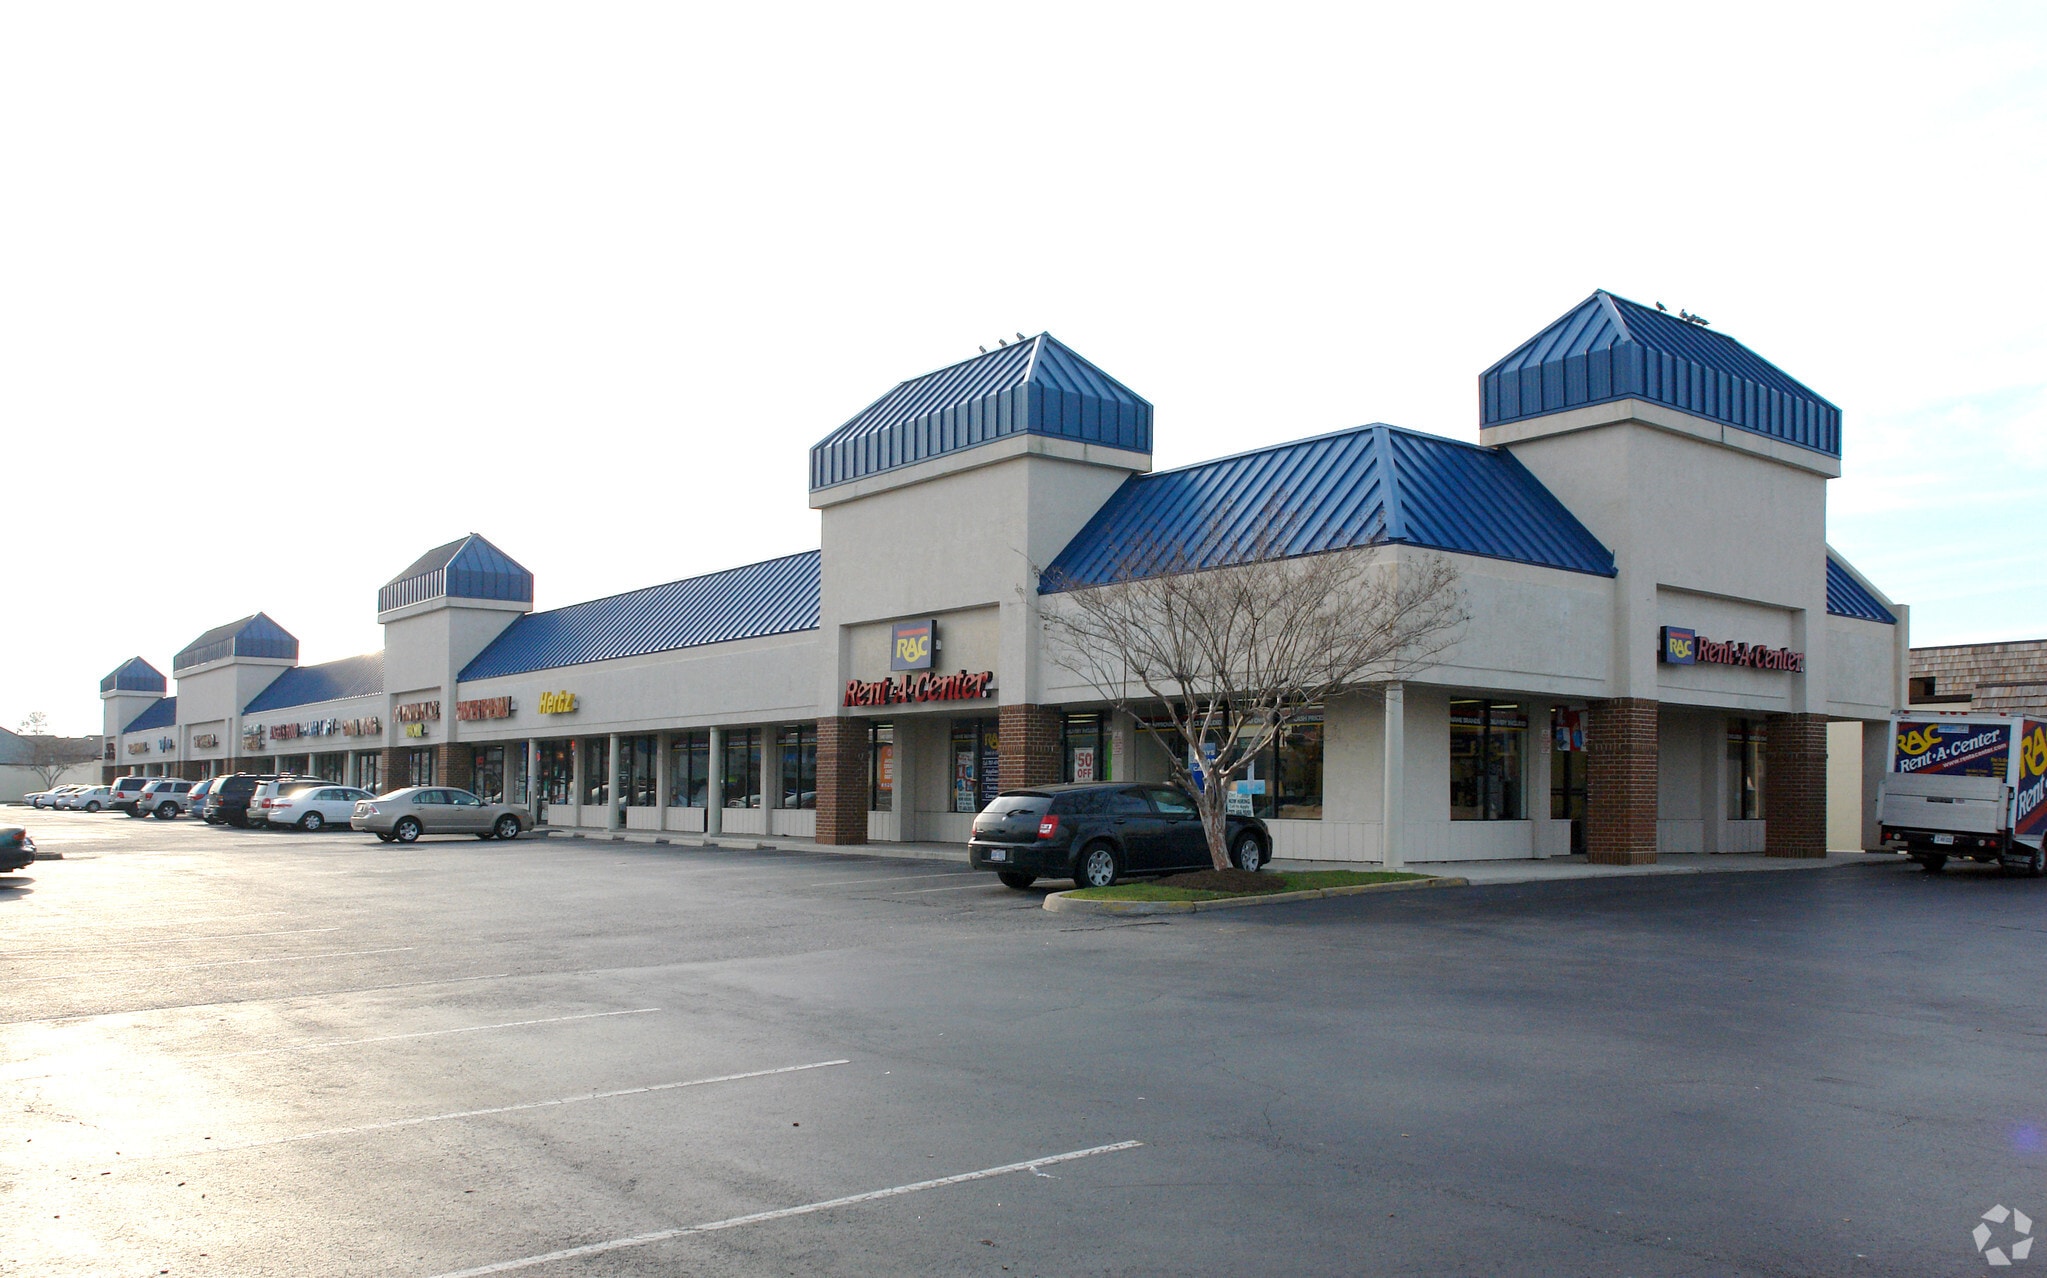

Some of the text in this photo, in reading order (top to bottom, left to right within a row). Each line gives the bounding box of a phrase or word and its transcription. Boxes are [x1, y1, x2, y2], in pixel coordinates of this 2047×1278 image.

[896, 636, 928, 662] RAC
[1669, 637, 1692, 659] RAC
[538, 690, 576, 714] Hertz
[1942, 743, 2007, 768] www.rentacenter.com
[2019, 726, 2047, 779] RA
[1077, 768, 1092, 778] OFF
